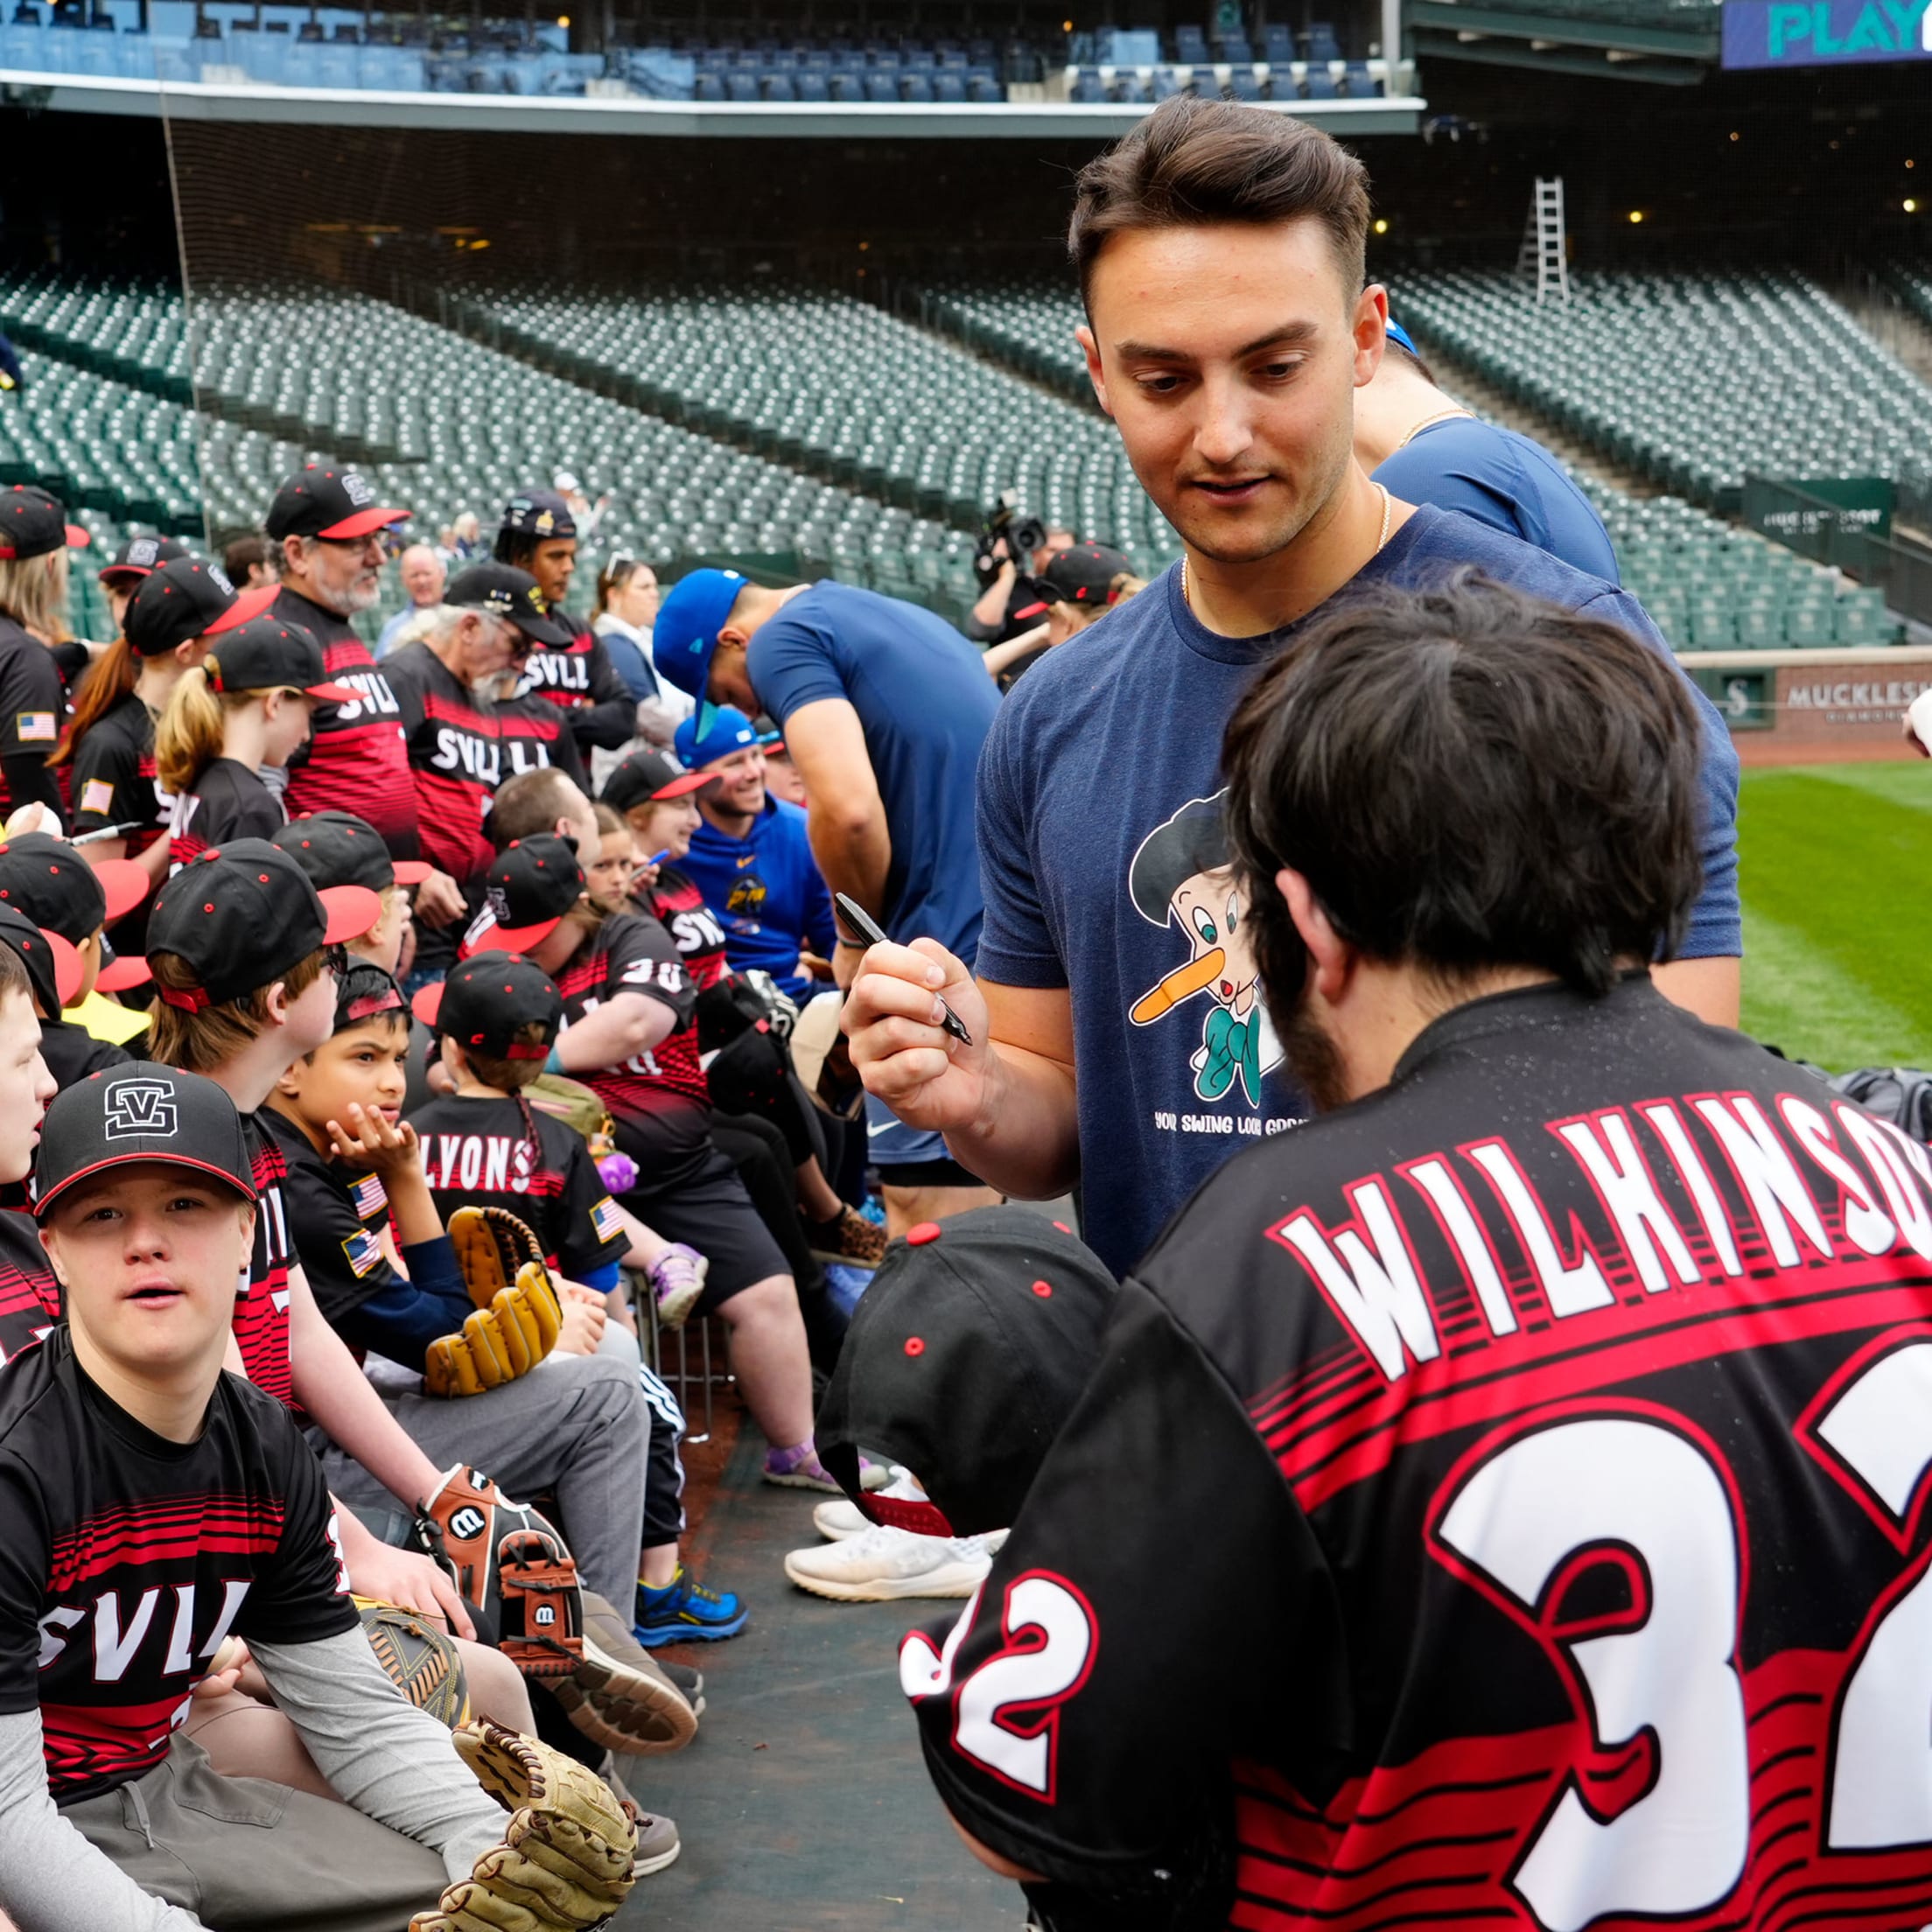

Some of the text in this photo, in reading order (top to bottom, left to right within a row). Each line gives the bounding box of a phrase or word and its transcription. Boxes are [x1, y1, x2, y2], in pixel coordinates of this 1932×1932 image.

[1768, 0, 1924, 60] PLAY
[526, 654, 589, 689] SVLL
[1180, 1114, 1234, 1135] SWING
[418, 1134, 533, 1194] LYONS
